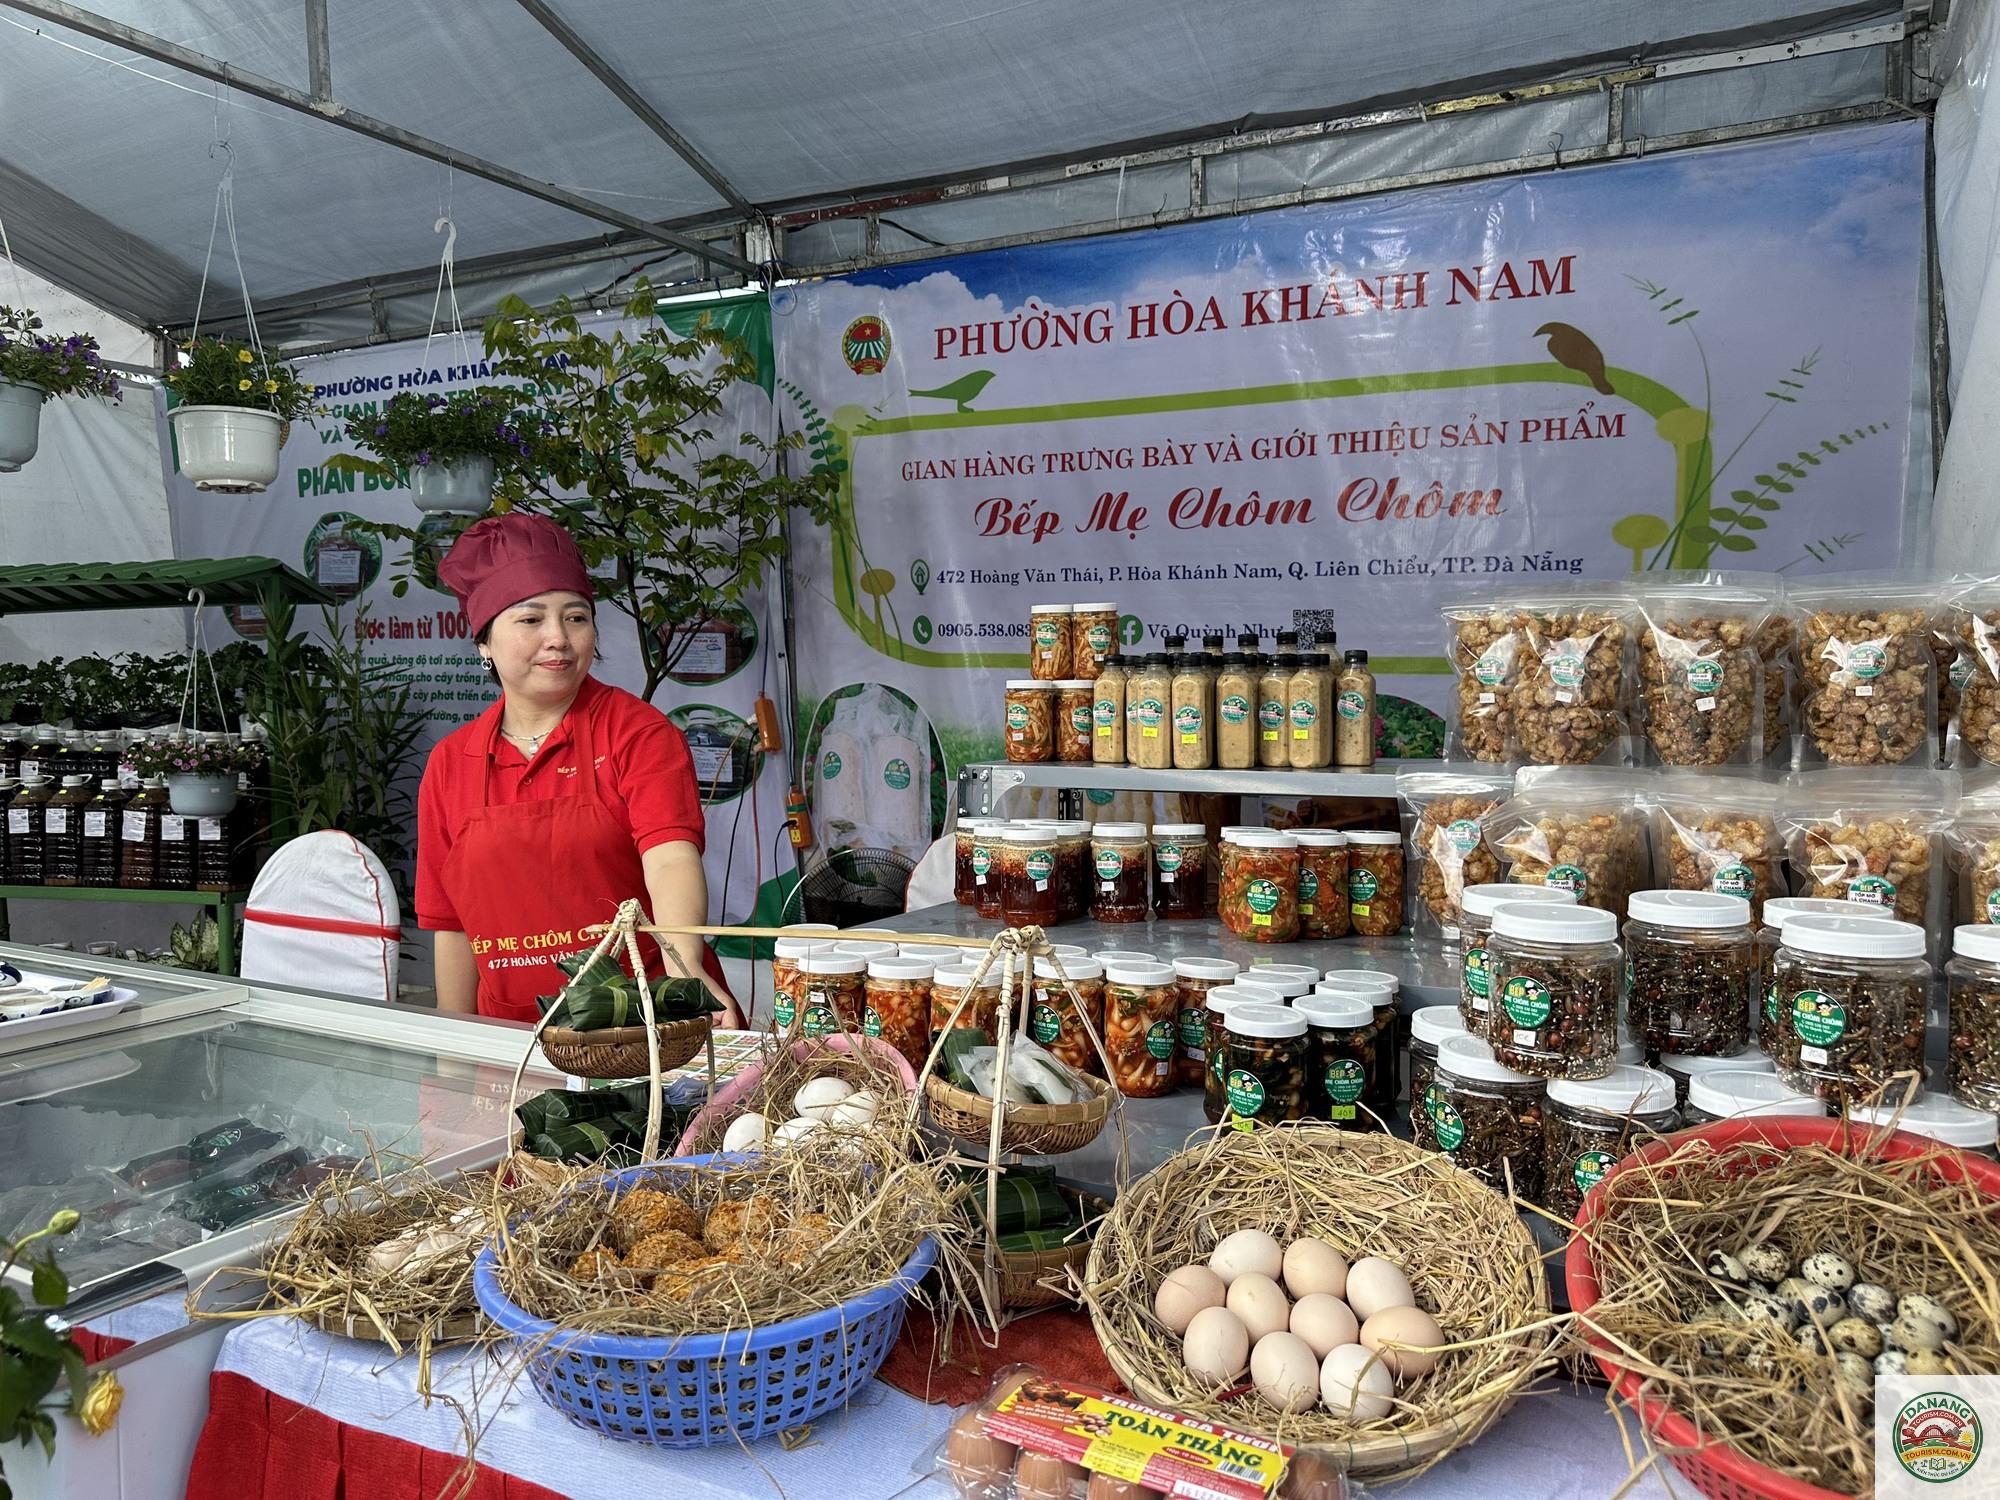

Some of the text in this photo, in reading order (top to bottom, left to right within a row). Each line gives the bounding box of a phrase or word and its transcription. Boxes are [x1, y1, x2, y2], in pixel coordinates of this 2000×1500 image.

[933, 255, 1577, 360] PHƯỜNG HÒA KHÁNH NAM
[314, 376, 393, 399] PHƯỜNG
[398, 367, 443, 388] HÒA
[332, 401, 377, 418] GIAN
[320, 425, 343, 444] VÀ
[902, 401, 1626, 482] GIAN HÀNG TRƯNG BÀY VÀ GIỚI THIỆU SẢN PHẨM
[974, 476, 1508, 544] Bếp Mẹ Chôm Chôm
[936, 550, 1584, 585] 472 Hoàng Văn Thái, P. Hòa Khánh Nam, Q. Liên Chiểu, TP. Đà Nẵng
[389, 615, 415, 640] làm
[417, 614, 434, 640] từ
[937, 623, 1032, 638] 0905.538.083
[1147, 624, 1170, 639] Võ
[1176, 623, 1236, 641] Quỳnh
[1243, 623, 1283, 639] Như
[416, 654, 427, 667] độ
[445, 653, 463, 668] xốp
[416, 672, 432, 682] cho
[435, 672, 453, 685] cây
[413, 690, 429, 702] cây
[431, 690, 454, 702] phát
[496, 937, 519, 954] MẸ
[523, 929, 572, 949] CHÔM
[488, 951, 574, 970] 472 HOÀNG VĂN
[1508, 982, 1525, 997] BẾP
[1512, 997, 1529, 1006] CHÔM
[1530, 1000, 1549, 1009] CHÔM
[1797, 996, 1816, 1012] BẾP
[1802, 1012, 1820, 1022] CHÔM
[1822, 1017, 1843, 1027] CHÔM
[1329, 1066, 1345, 1079] BẾP
[1230, 1075, 1243, 1088] BẾP
[1247, 1092, 1262, 1100] CHÔM
[1579, 1158, 1600, 1171] BẾP
[1106, 1410, 1172, 1440] TOÀN
[1181, 1417, 1214, 1434] GÀ
